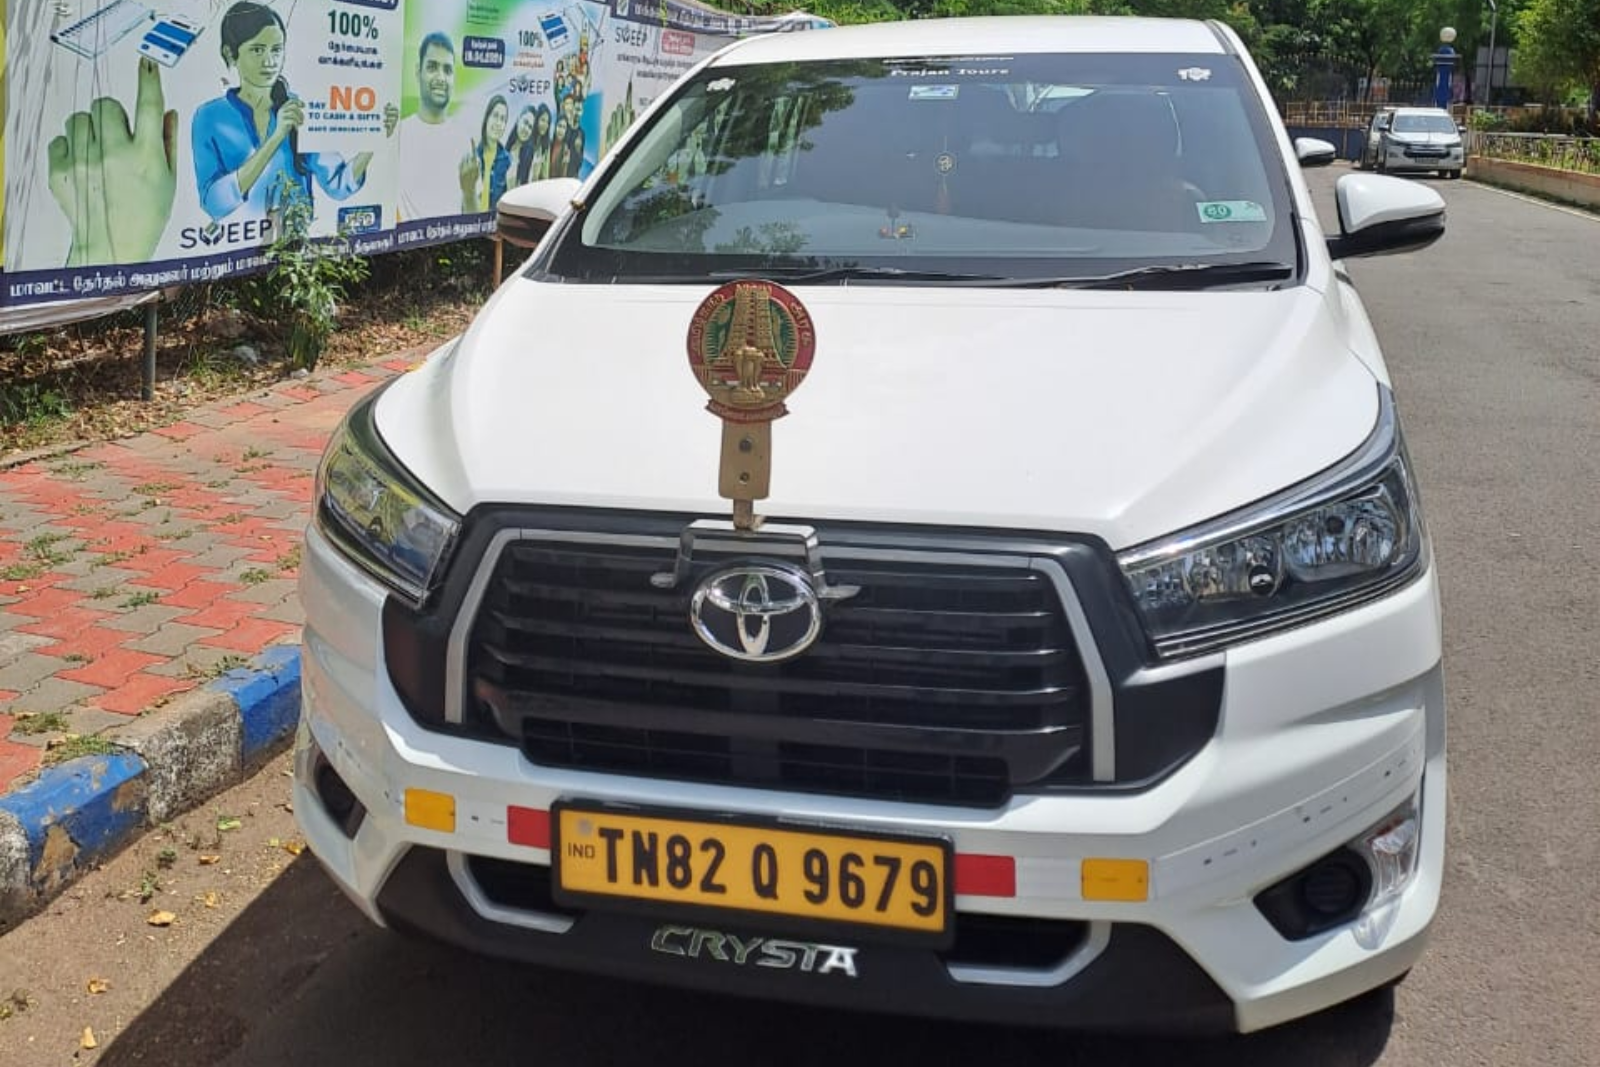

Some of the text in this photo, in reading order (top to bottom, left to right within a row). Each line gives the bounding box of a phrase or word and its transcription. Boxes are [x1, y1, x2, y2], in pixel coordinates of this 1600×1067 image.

[327, 9, 379, 39] 100%
[615, 27, 647, 47] SWEEP
[307, 85, 376, 112] SAY NO
[509, 77, 550, 95] SWEEP
[307, 112, 321, 120] TO
[180, 219, 273, 248] SWEEP
[9, 279, 70, 297] மாவட்ட
[72, 270, 126, 295] தேர்தல்
[129, 263, 188, 288] அலுவலர்
[191, 257, 234, 281] மற்றும்
[567, 843, 595, 859] IND
[598, 827, 939, 917] TN82 Q 9679
[650, 923, 859, 977] CRYSTA
